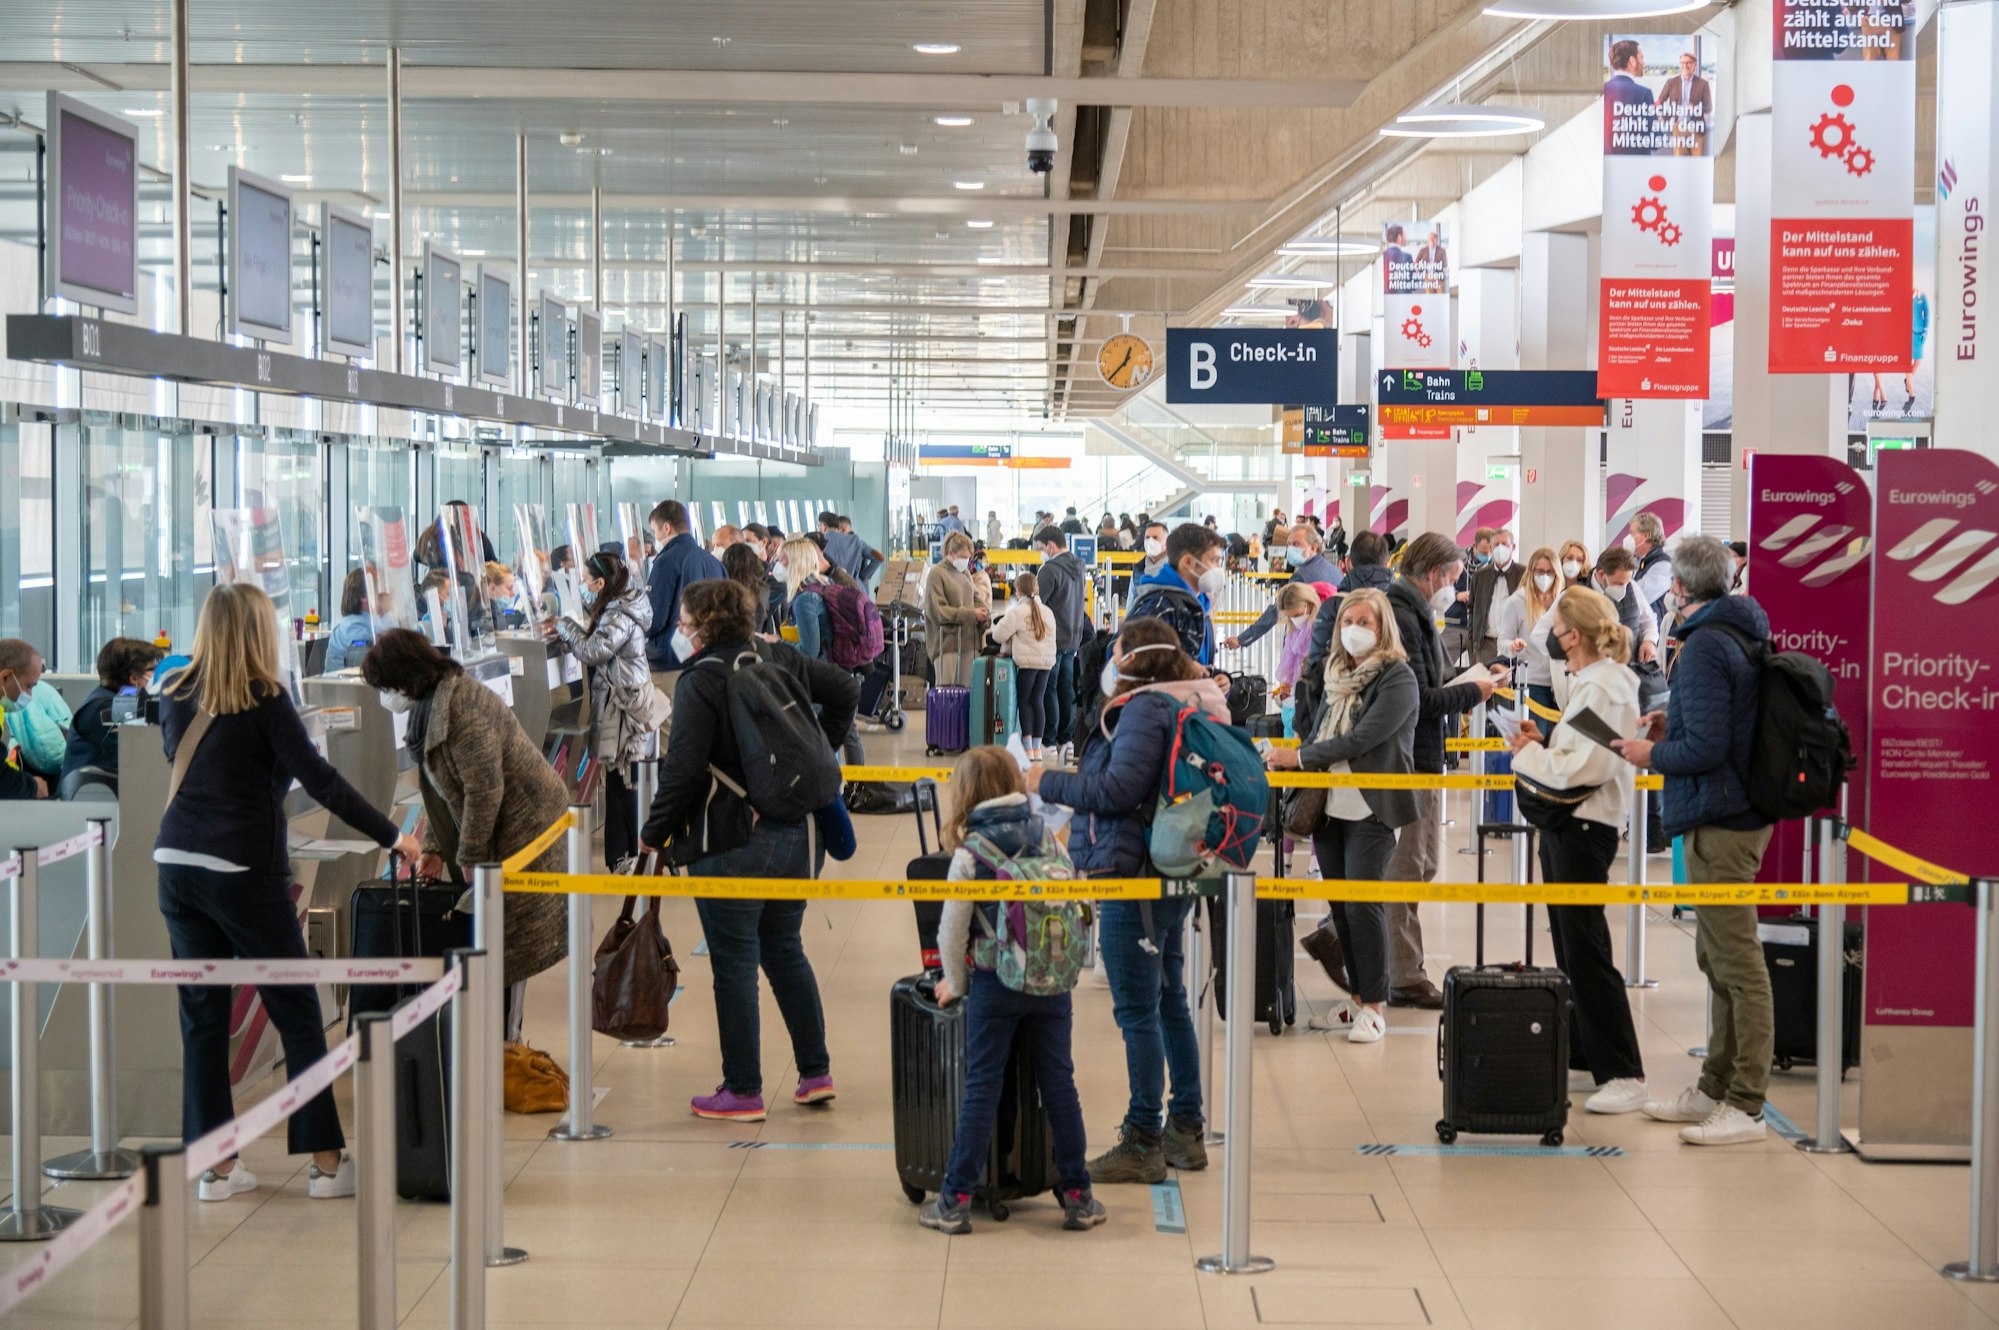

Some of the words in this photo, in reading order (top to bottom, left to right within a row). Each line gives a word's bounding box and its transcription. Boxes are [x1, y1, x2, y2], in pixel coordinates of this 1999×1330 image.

[1784, 9, 1830, 27] zählt
[1835, 10, 1865, 27] auf
[1868, 10, 1902, 27] den
[1784, 30, 1895, 48] Mittelstand.
[1613, 101, 1702, 117] Deutschland
[1612, 117, 1648, 132] zählt
[1652, 117, 1674, 132] auf
[1678, 118, 1704, 132] den
[1612, 133, 1699, 148] Mittelstand.
[1783, 232, 1802, 242] Der
[1806, 231, 1872, 242] Mittelstand
[1783, 246, 1810, 256] kann
[1814, 245, 1832, 256] auf
[1835, 248, 1855, 257] uns
[1858, 246, 1900, 258] zählen.
[1389, 260, 1442, 271] Deutschland
[1389, 270, 1410, 280] zählt
[1428, 271, 1444, 280] den
[1957, 198, 1984, 360] Eurowings
[1389, 280, 1440, 290] Mittelstand.
[1610, 288, 1626, 297] Der
[1628, 288, 1680, 298] Mittelstand
[1610, 299, 1632, 308] kann
[1634, 299, 1649, 308] auf
[1650, 301, 1666, 309] uns
[1668, 300, 1701, 310] zählen.
[82, 323, 100, 356] B01
[1840, 354, 1898, 364] Finanzgruppe
[258, 355, 271, 382] B02
[1190, 342, 1217, 390] B
[1230, 342, 1316, 362] Check-in
[1426, 376, 1450, 386] Bahn
[1654, 384, 1699, 392] Finanzgruppe
[1426, 390, 1456, 400] Trains
[1863, 409, 1924, 418] eurowings.com
[1762, 489, 1836, 506] Eurowings
[1889, 489, 1976, 508] Eurowings
[1769, 629, 1848, 655] riority-
[1884, 652, 1990, 682] Priority-
[1882, 685, 1999, 710] Check-in
[504, 877, 525, 886] Bonn
[528, 878, 559, 888] Airport
[909, 886, 928, 894] Köln
[931, 886, 950, 894] Bonn
[954, 886, 986, 896] Airport
[1047, 885, 1065, 894] Köln
[1069, 885, 1088, 894] Bonn
[1092, 885, 1124, 895] Airport
[1273, 884, 1304, 894] Airport
[1792, 890, 1810, 898] Köln
[1814, 890, 1833, 898] Bonn
[1838, 890, 1870, 899] Airport
[1654, 891, 1672, 899] Köln
[1676, 891, 1695, 899] Bonn
[1700, 890, 1731, 900] Airport
[152, 968, 203, 980] Eurowings
[348, 968, 399, 979] Eurowings
